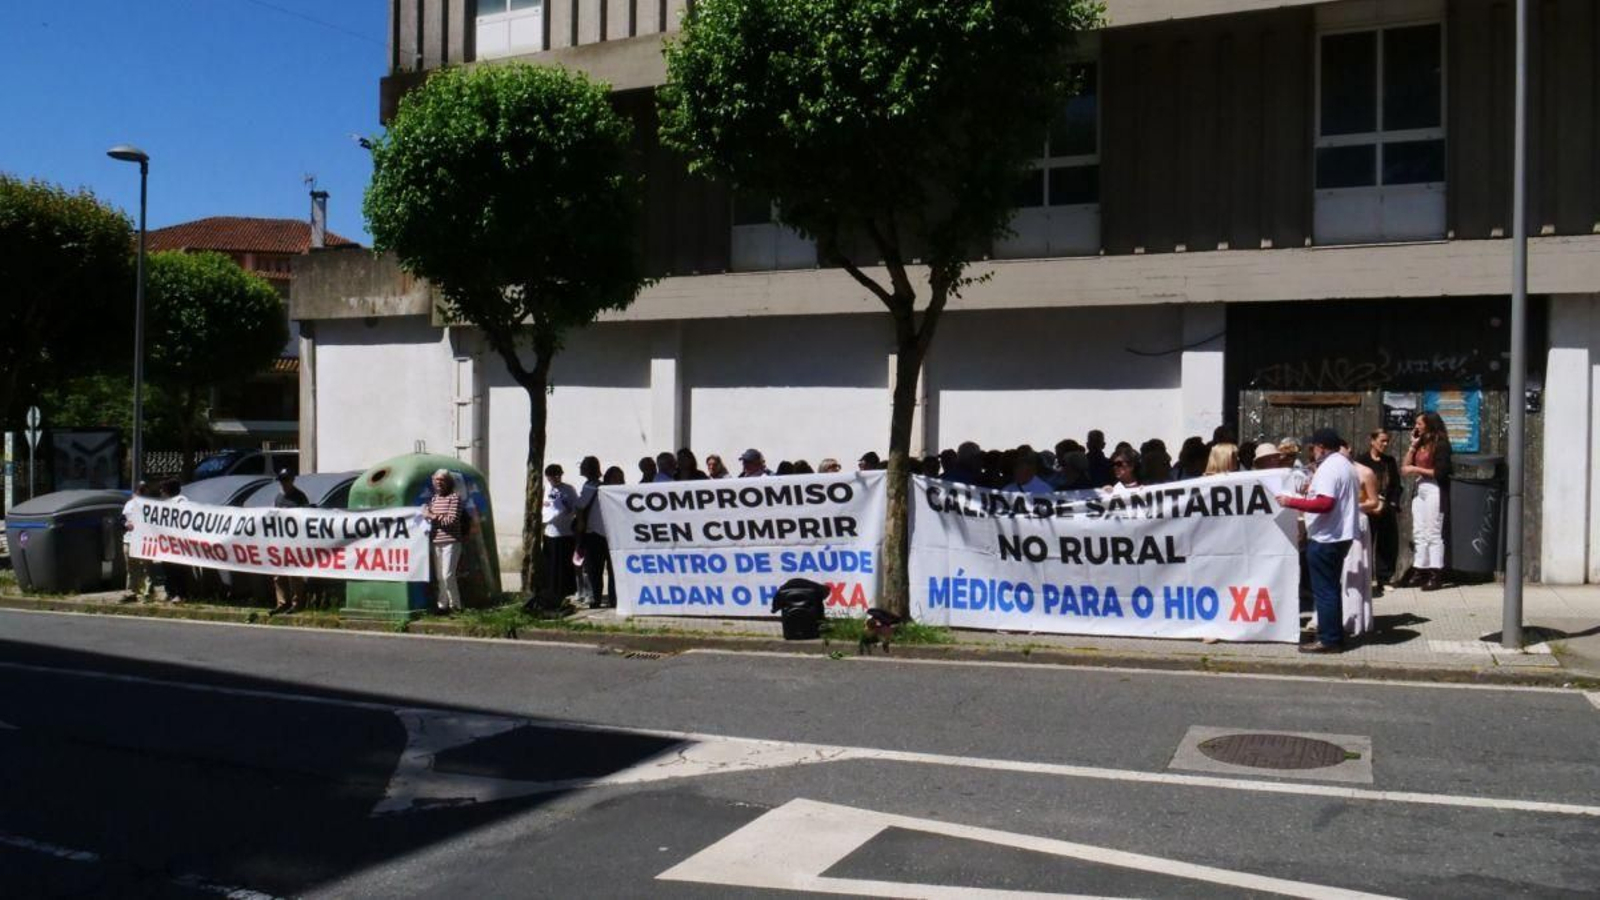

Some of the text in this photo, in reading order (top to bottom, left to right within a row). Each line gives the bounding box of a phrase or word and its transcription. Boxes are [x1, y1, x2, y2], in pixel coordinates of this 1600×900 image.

[625, 482, 854, 512] COMPROMISO
[926, 484, 1273, 519] CALIDADE SANITARIA
[143, 505, 410, 540] PARROQUIA DO HIO EN LOITA
[633, 516, 858, 542] SEN CUMPRIR
[235, 544, 262, 565] DE
[269, 545, 346, 568] SAUDE
[354, 548, 409, 572] XA!!!
[626, 544, 874, 574] CENTRO DE SAÚDE
[998, 535, 1186, 564] NO RURAL
[638, 585, 725, 606] ALDAN
[732, 586, 752, 606] O
[825, 581, 868, 610] XA
[928, 568, 1276, 622] MÉDICO PARA O HIO XA
